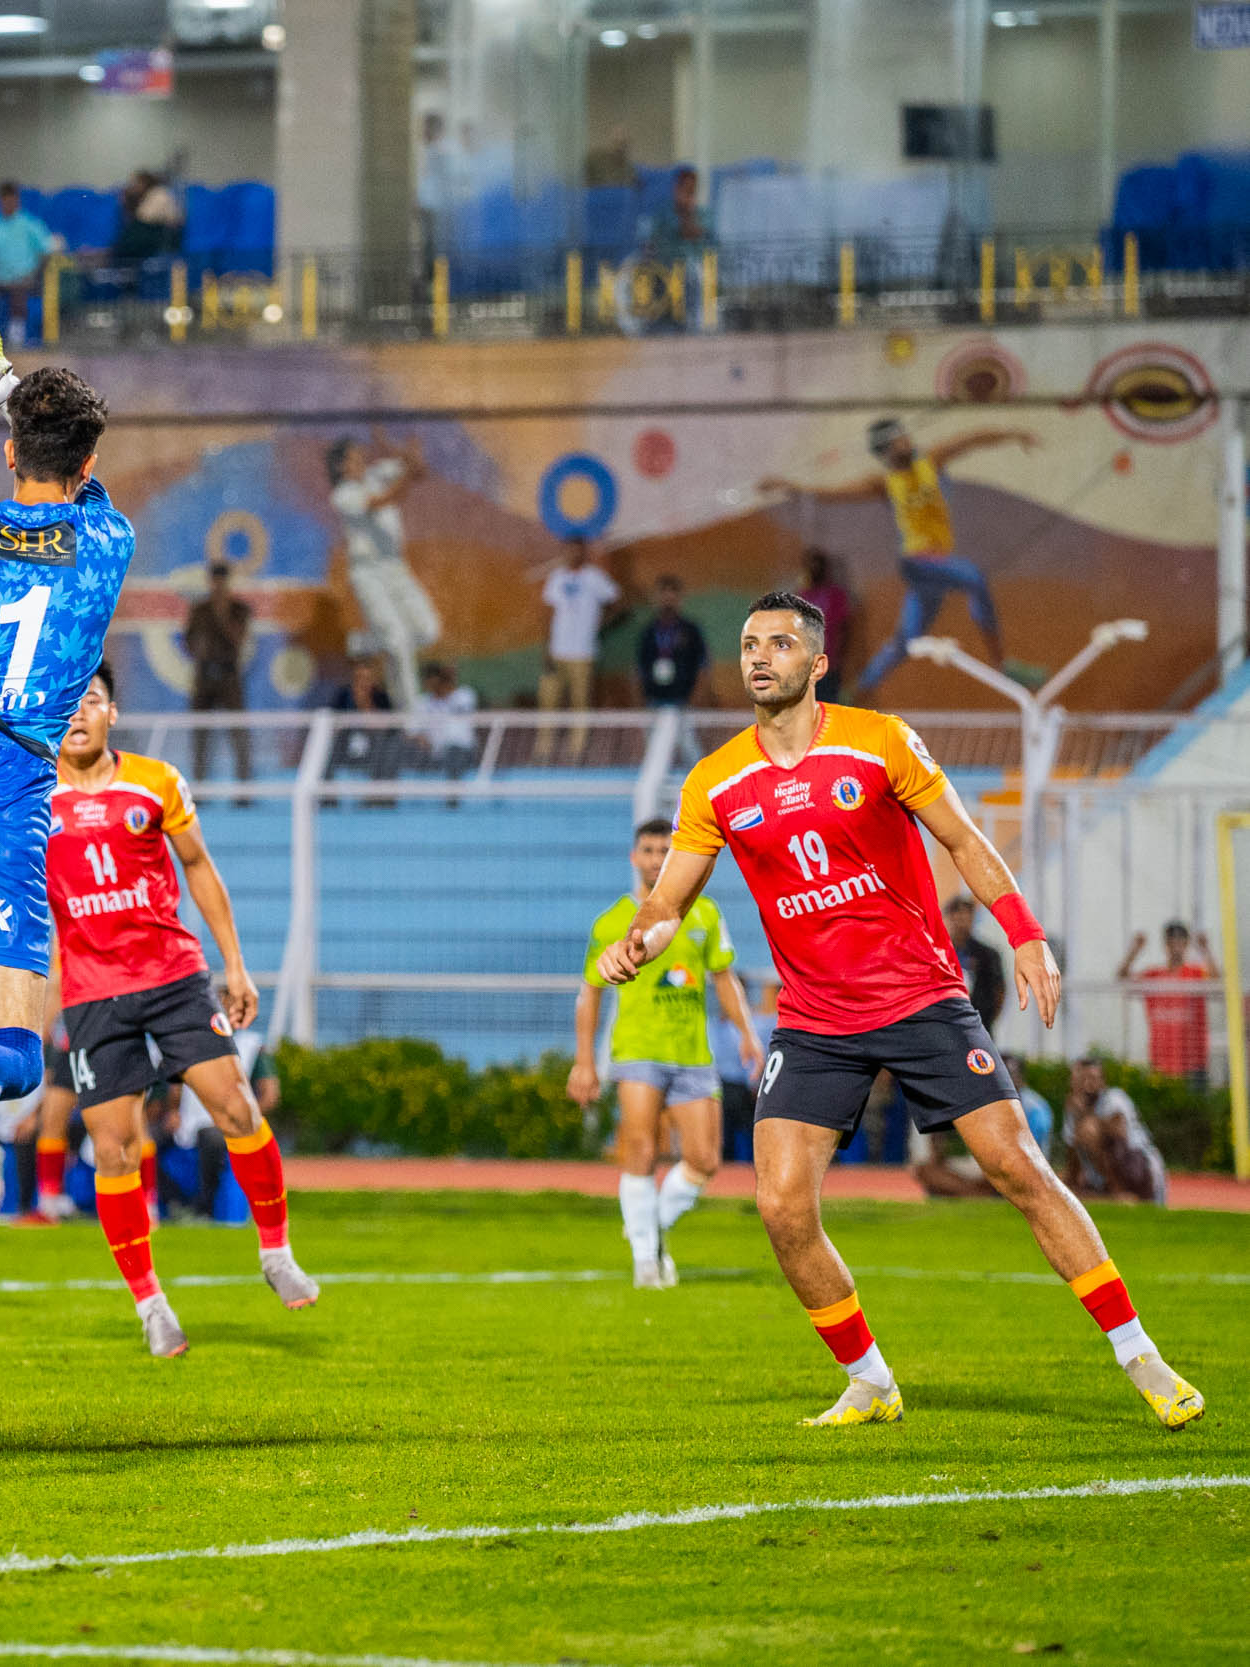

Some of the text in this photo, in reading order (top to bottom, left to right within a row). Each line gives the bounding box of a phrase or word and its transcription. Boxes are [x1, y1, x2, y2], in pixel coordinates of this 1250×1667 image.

[774, 781, 811, 799] Healthy
[84, 843, 118, 886] 14
[787, 829, 829, 882] 19
[66, 876, 151, 919] emami
[776, 864, 887, 919] emami
[69, 1048, 96, 1094] 14
